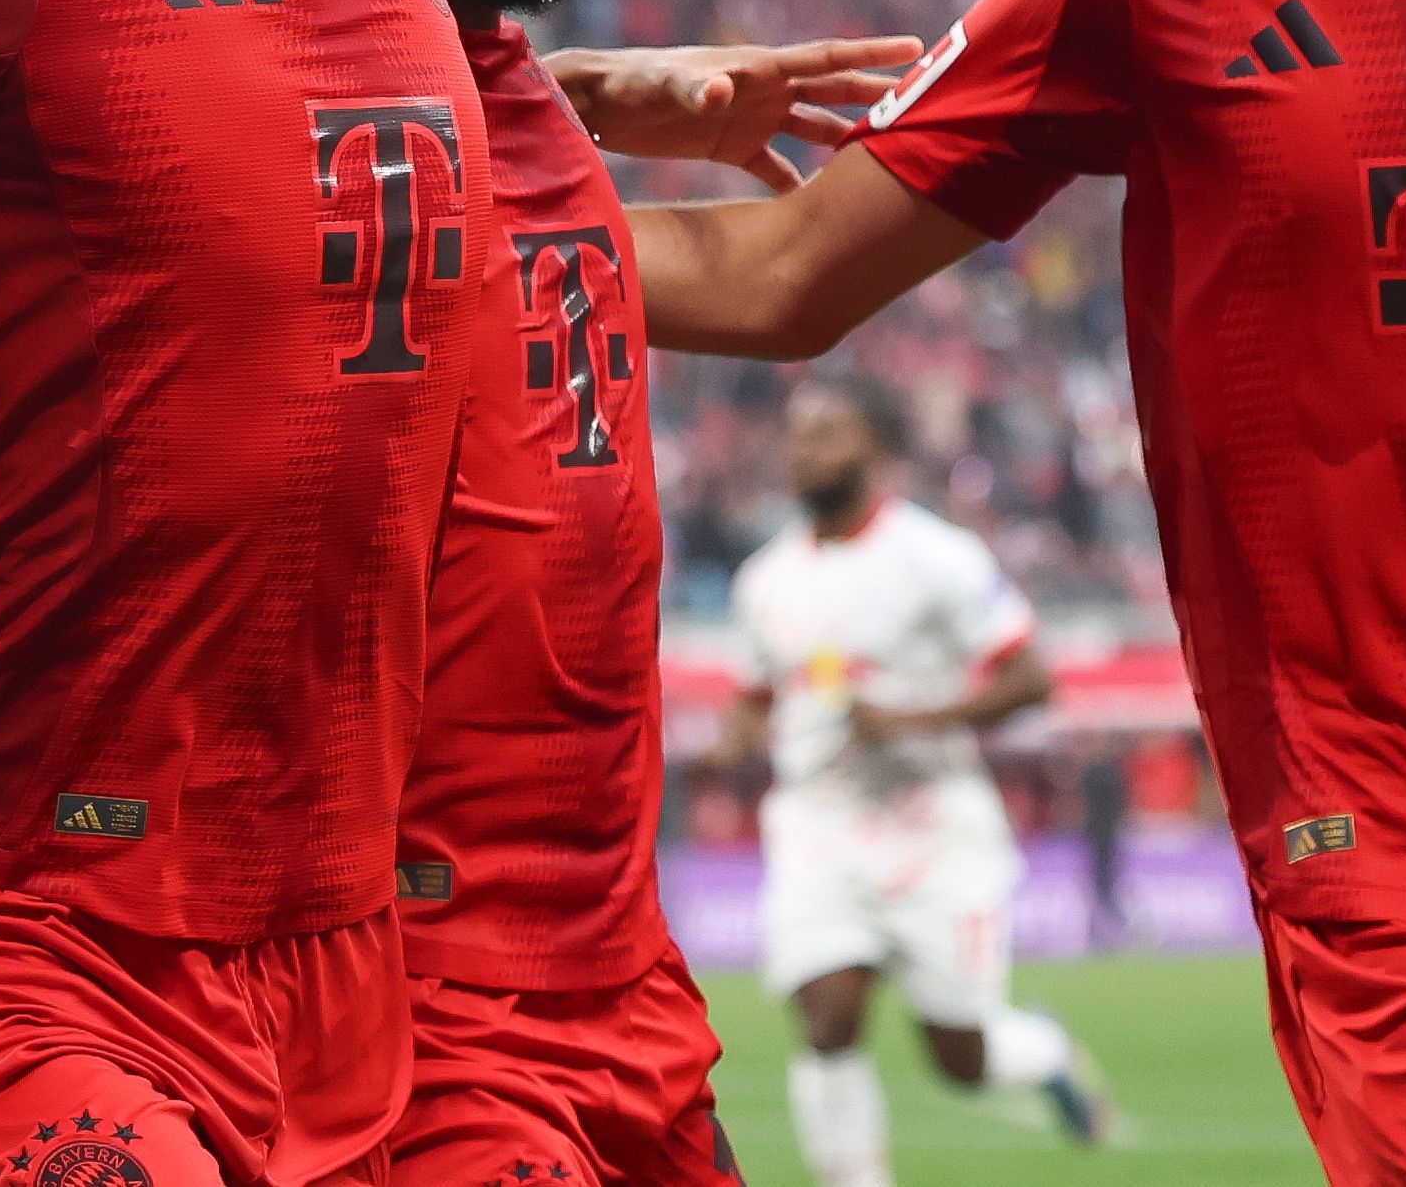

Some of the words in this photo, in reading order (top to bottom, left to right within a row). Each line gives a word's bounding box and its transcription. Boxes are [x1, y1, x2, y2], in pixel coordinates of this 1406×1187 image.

[310, 102, 466, 378] T
[509, 224, 634, 469] T
[48, 1146, 125, 1175] BAYERN
